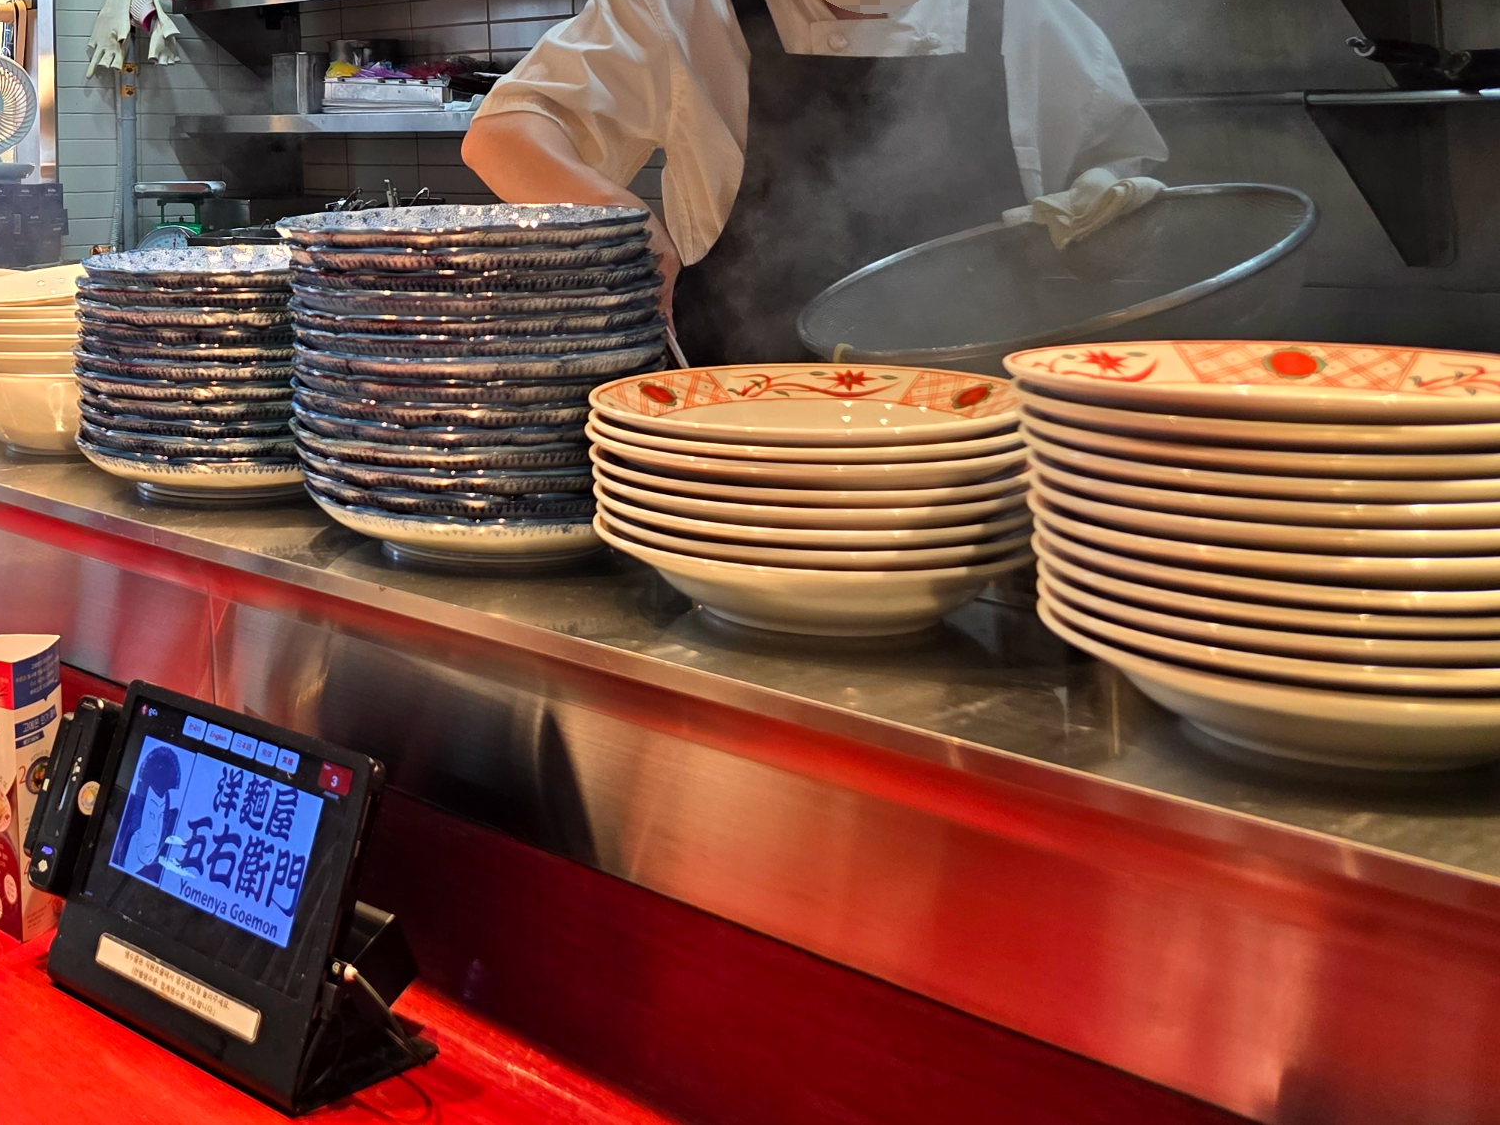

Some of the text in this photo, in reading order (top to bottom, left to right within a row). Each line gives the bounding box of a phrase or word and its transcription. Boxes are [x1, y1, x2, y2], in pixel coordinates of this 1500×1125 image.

[23, 718, 40, 733] 고에몬
[208, 730, 228, 743] English
[236, 739, 253, 751] 日本語
[19, 765, 26, 785] 2
[330, 775, 339, 787] 3
[178, 815, 306, 918] 五右衛門
[178, 878, 278, 939] Yomenya Goemon
